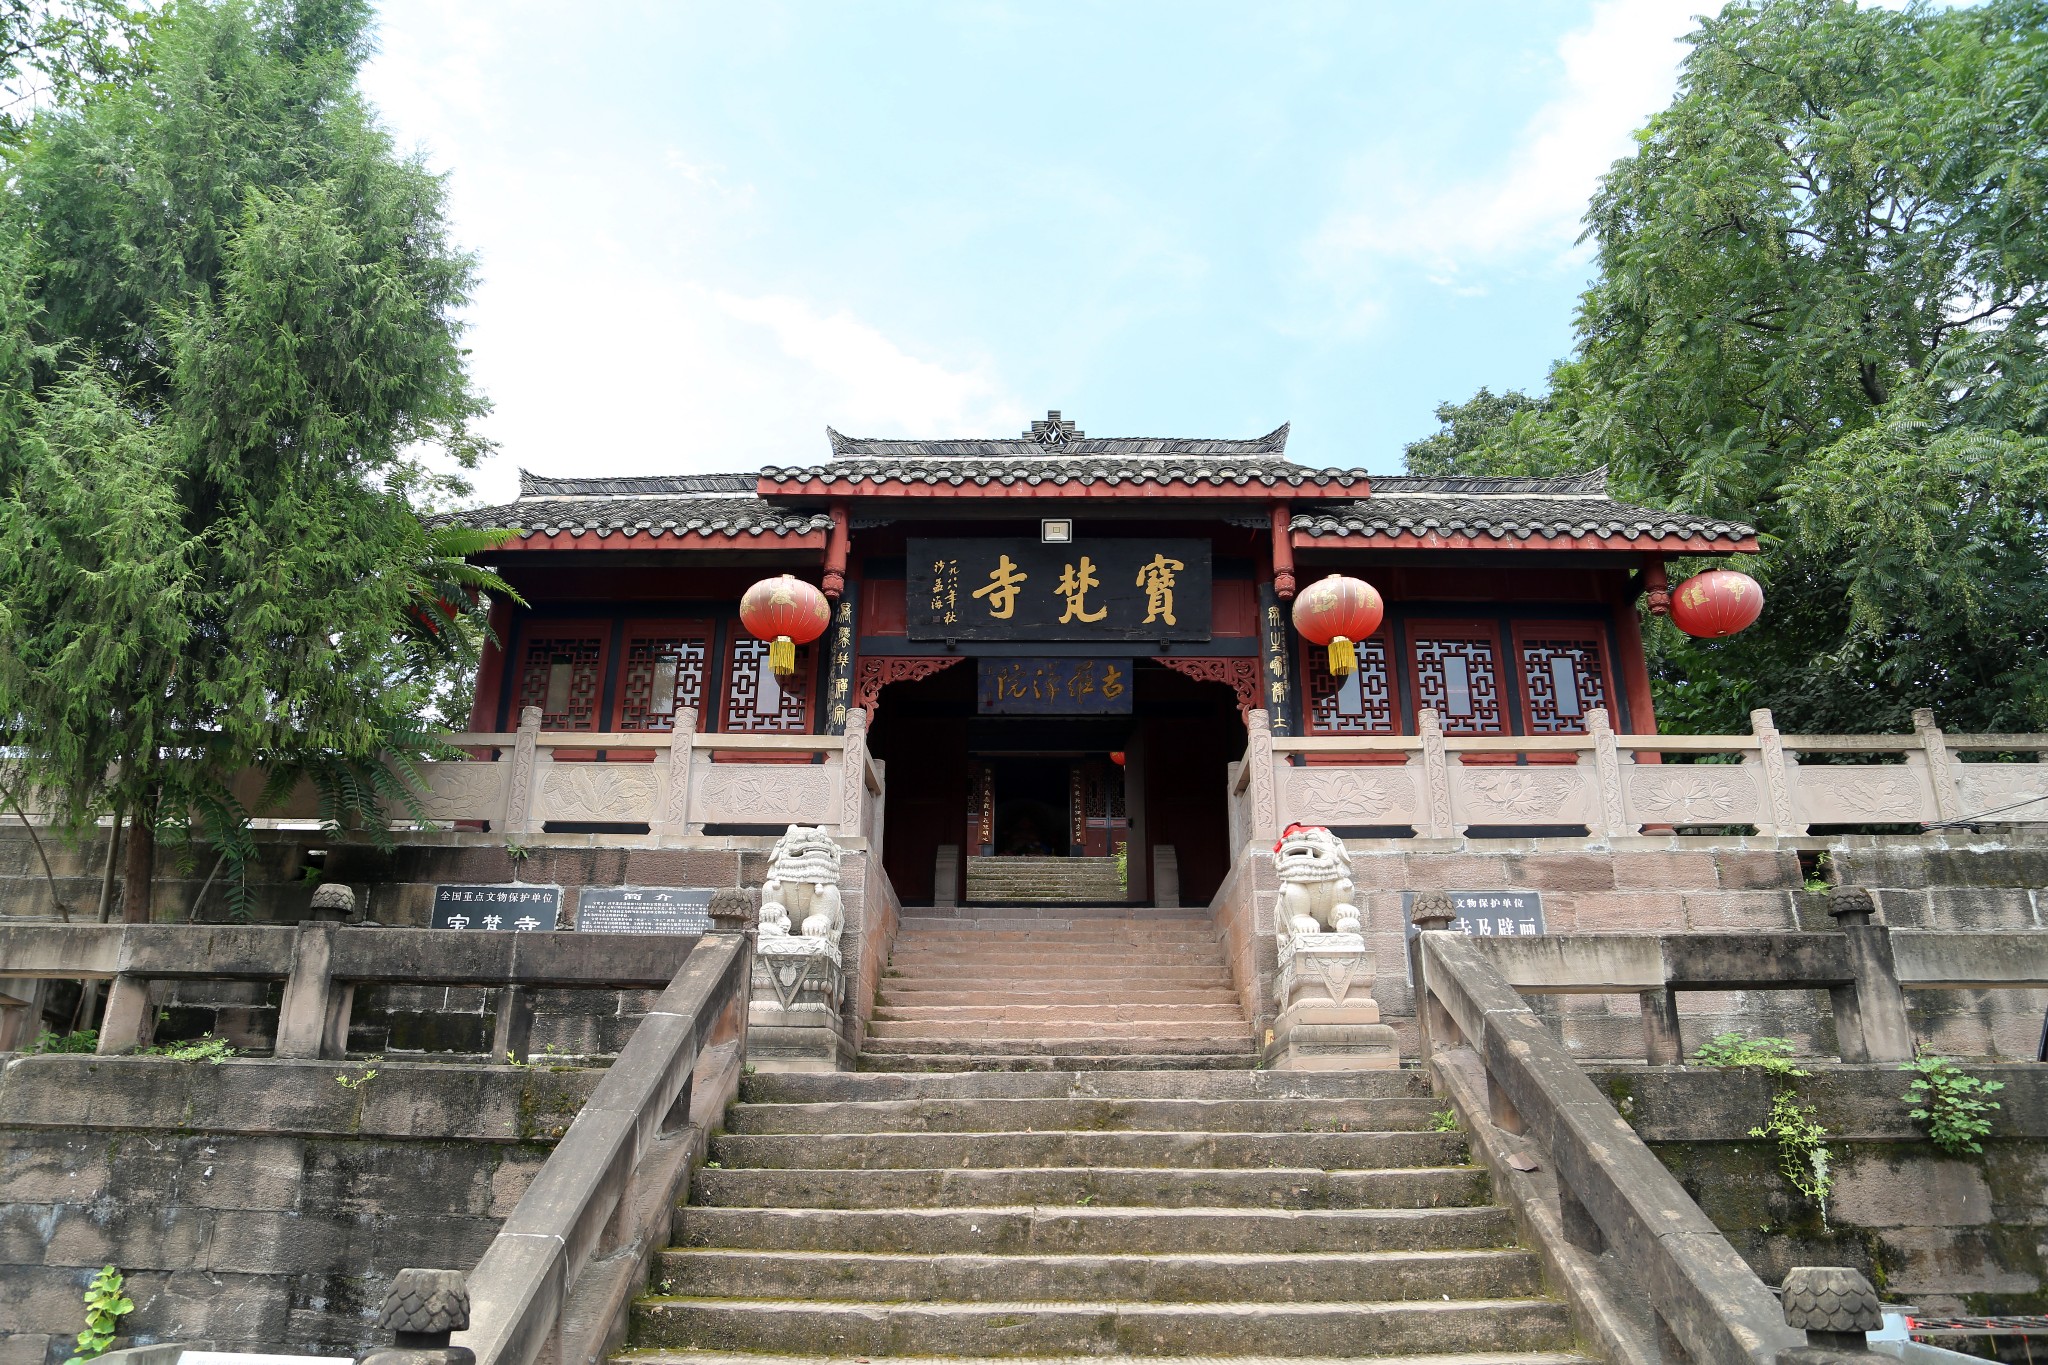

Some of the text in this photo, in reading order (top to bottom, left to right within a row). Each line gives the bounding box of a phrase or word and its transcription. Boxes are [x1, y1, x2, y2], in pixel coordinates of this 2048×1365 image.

[931, 559, 946, 610] 沙孟海
[943, 559, 961, 625] 一九八八年秋
[972, 553, 1184, 626] 寶梵寺
[440, 890, 553, 904] 全国重点文物保护单位
[622, 892, 674, 902] 简介
[1455, 898, 1525, 908] 文物保护单位
